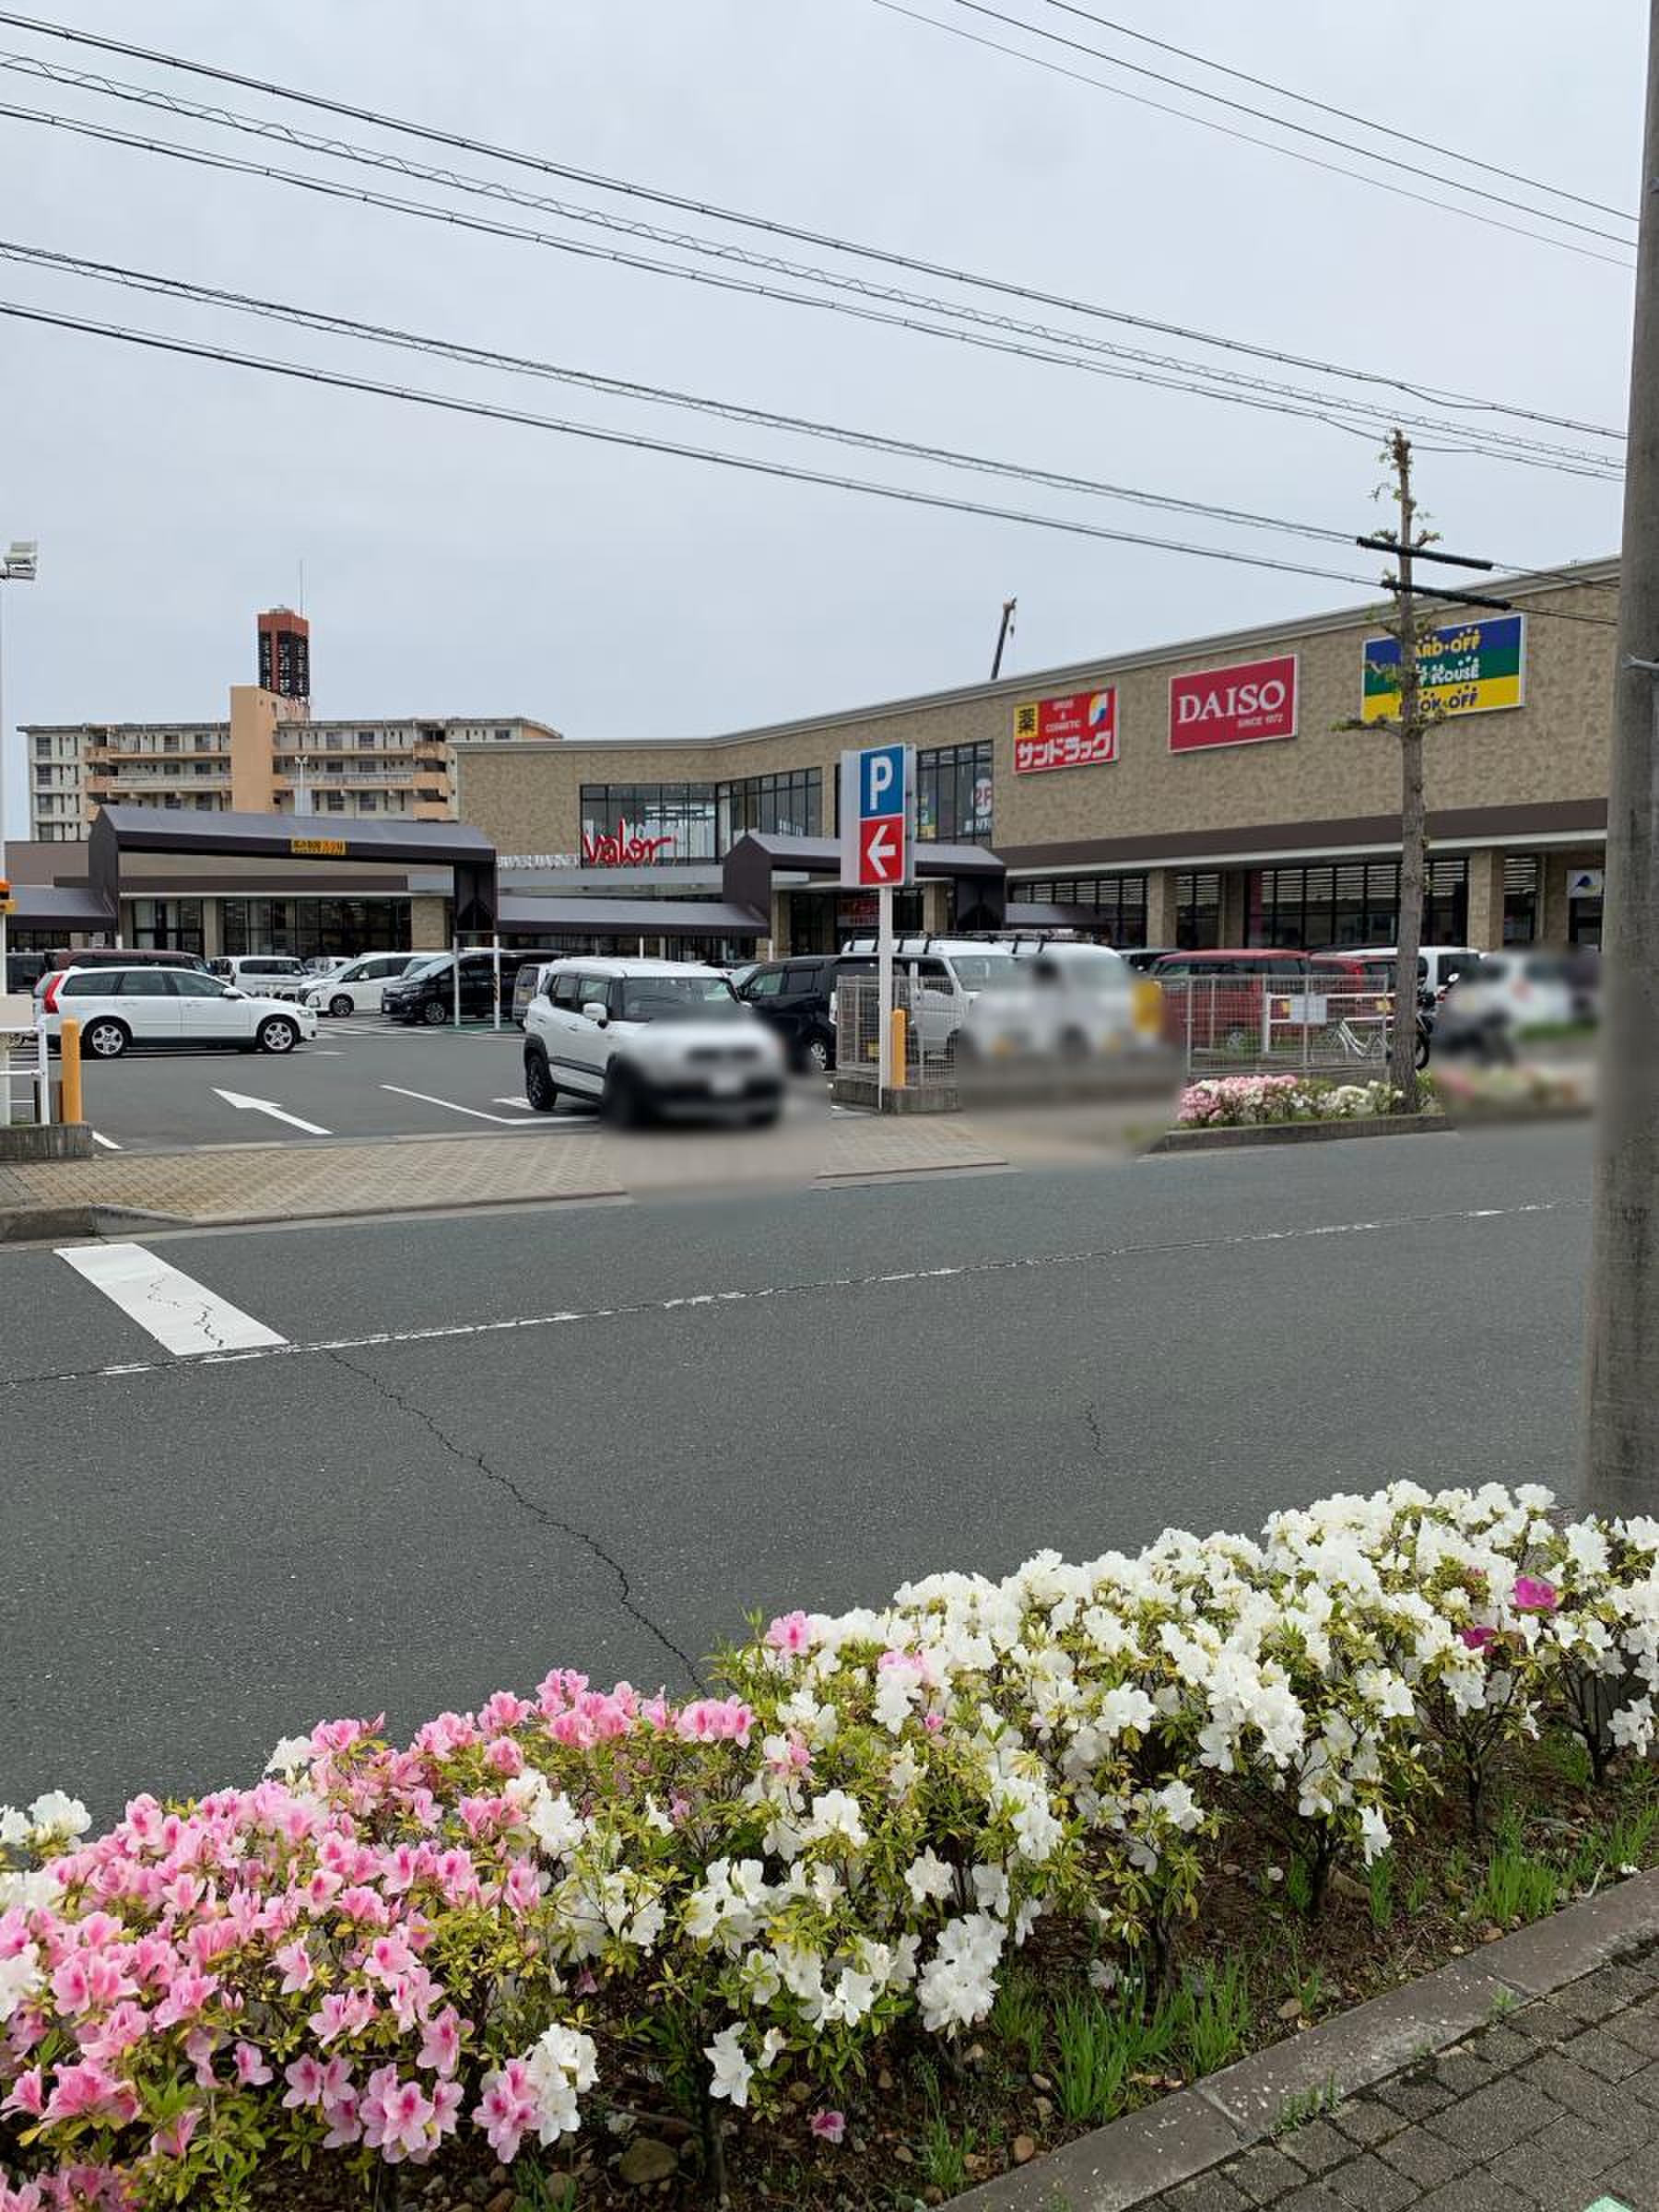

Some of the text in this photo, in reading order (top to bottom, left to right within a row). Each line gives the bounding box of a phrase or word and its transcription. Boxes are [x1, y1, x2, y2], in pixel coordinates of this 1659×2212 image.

[1018, 708, 1034, 735] 薬
[1177, 680, 1286, 724] DAISO
[1017, 732, 1112, 769] サンドラッグ
[869, 756, 893, 811] P
